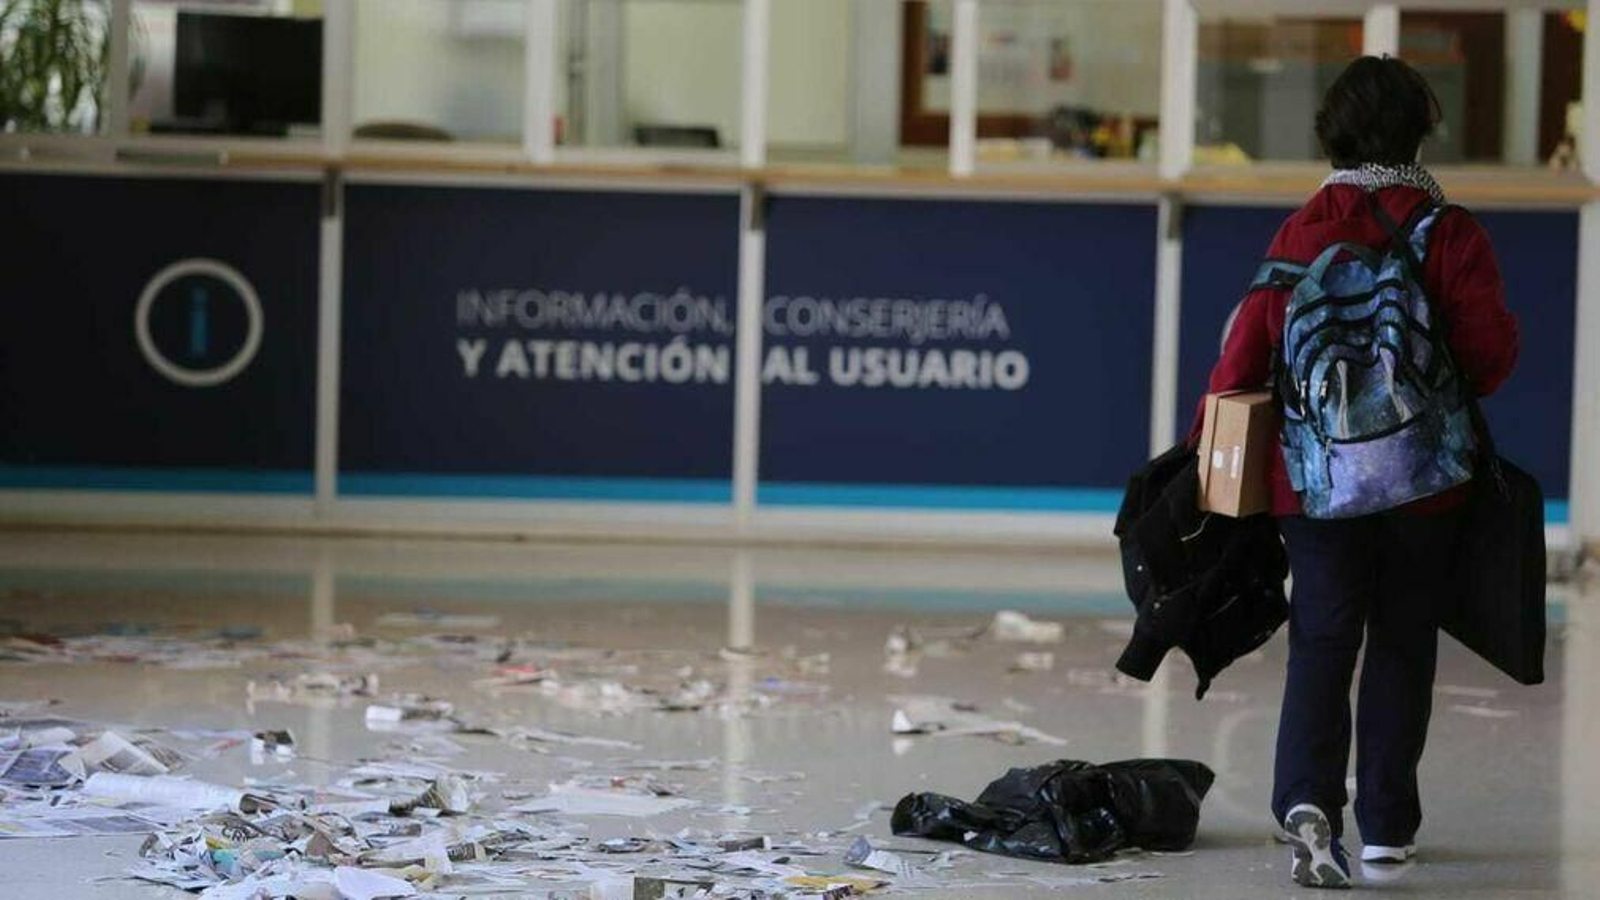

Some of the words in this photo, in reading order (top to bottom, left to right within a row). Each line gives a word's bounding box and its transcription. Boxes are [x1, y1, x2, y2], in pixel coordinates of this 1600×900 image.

[456, 286, 735, 337] INFORMACIÓN,
[763, 293, 1011, 344] CONSERJERÍA
[456, 338, 487, 378] Y
[496, 335, 731, 384] ATENCIÓN
[762, 346, 820, 386] AL
[829, 347, 1030, 390] USUARIO
